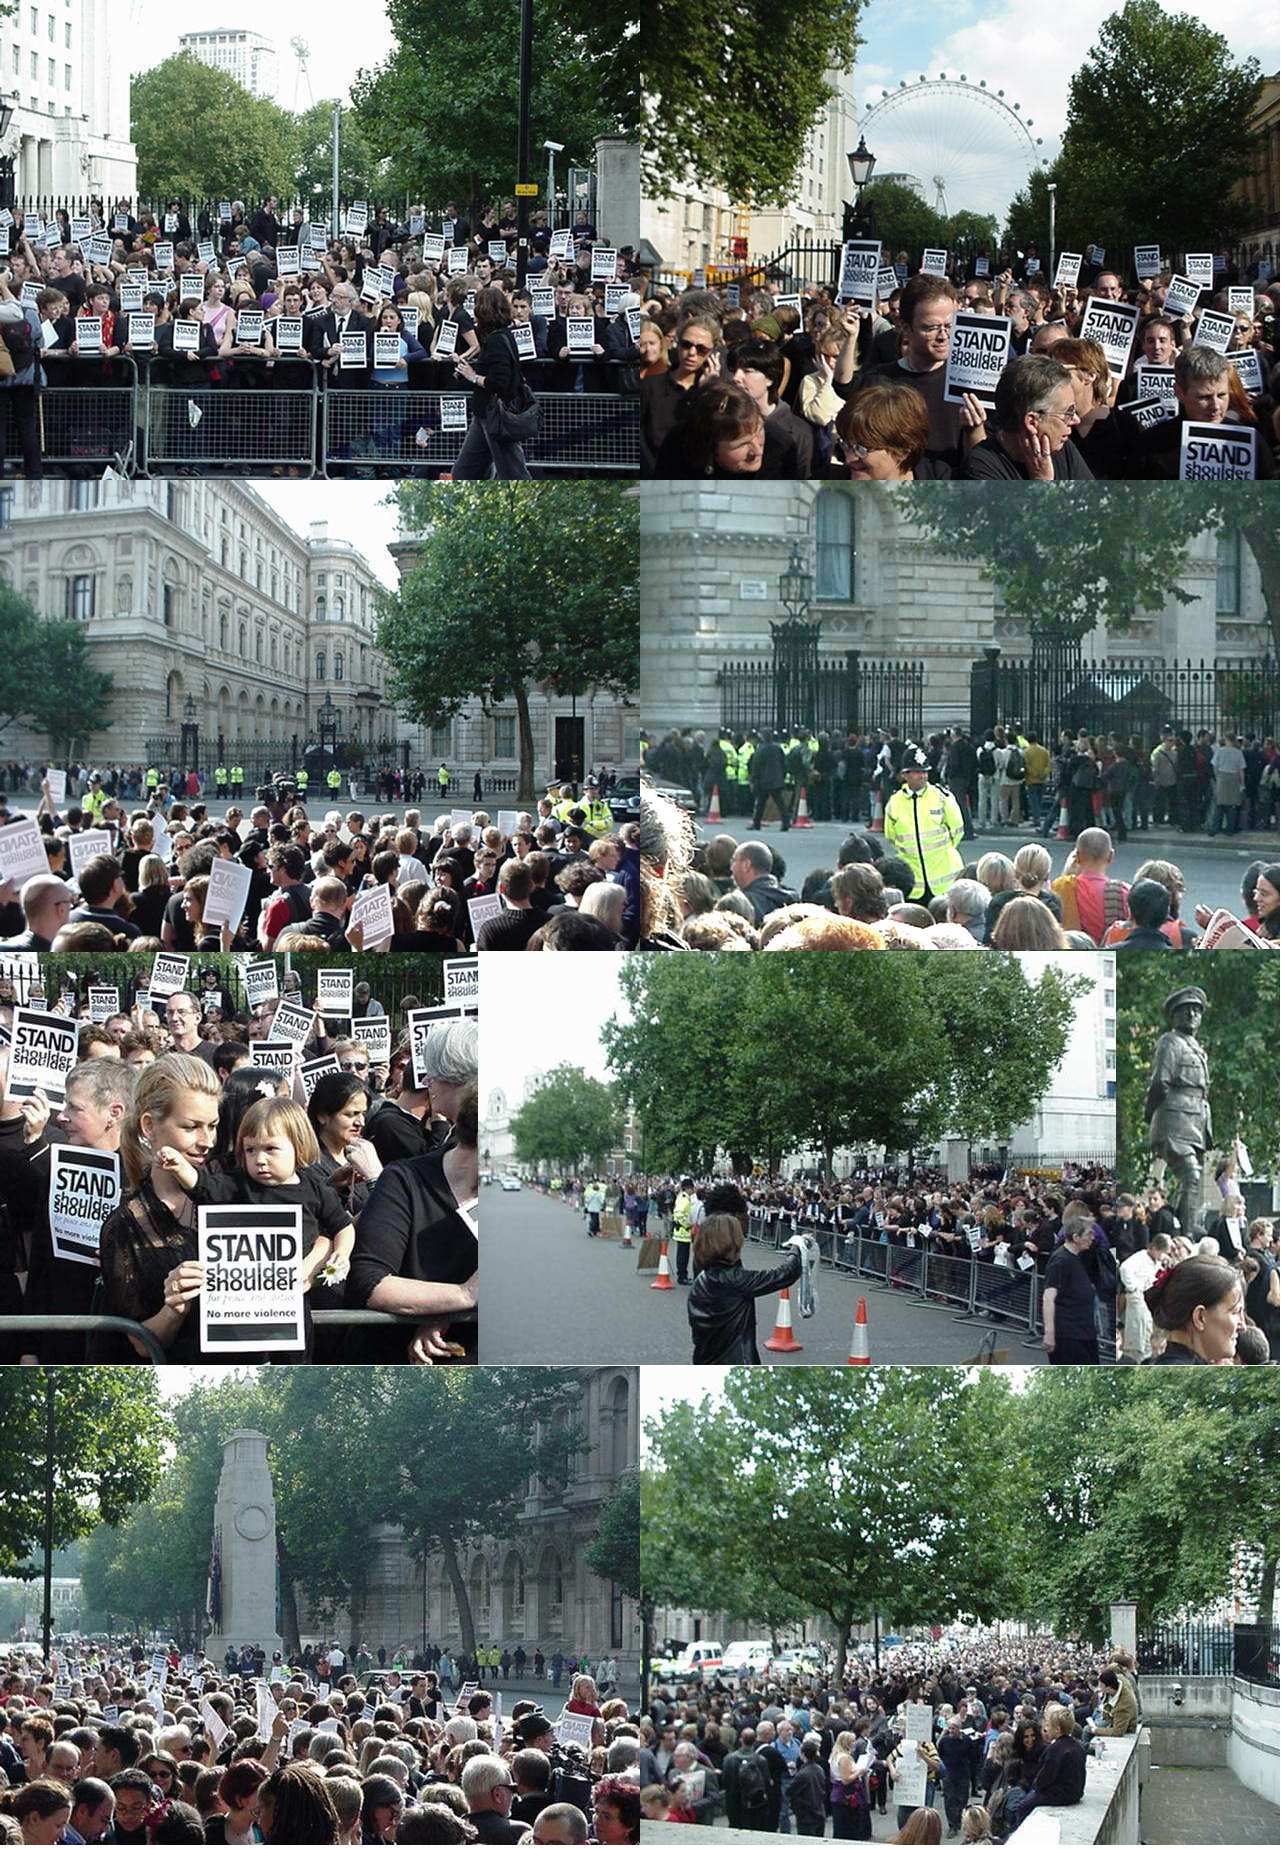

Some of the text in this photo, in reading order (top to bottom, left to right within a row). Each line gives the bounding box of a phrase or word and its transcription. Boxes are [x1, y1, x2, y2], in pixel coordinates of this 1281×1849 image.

[594, 255, 615, 263] STAND
[845, 253, 877, 269] STAND
[925, 255, 945, 265] STAND
[1136, 252, 1158, 262] STAND
[1188, 261, 1211, 269] STAND
[182, 280, 203, 288] STAND
[1170, 282, 1198, 298] STAND
[131, 320, 153, 328] STAND
[240, 316, 262, 325] STAND
[1086, 312, 1133, 334] STAND
[1201, 318, 1232, 336] STAND
[78, 323, 101, 332] STAND
[176, 327, 198, 336] STAND
[279, 323, 301, 332] STAND
[568, 324, 592, 332] STAND
[342, 338, 365, 347] STAND
[376, 338, 399, 347] STAND
[953, 329, 1006, 353] STAND
[442, 401, 465, 410] STAND
[1186, 441, 1252, 466] STAND
[156, 961, 186, 976] STAND
[246, 969, 275, 985] STAND
[320, 978, 351, 989] STAND
[447, 970, 478, 985] STAN
[91, 995, 117, 1005] STAND
[276, 1011, 310, 1031] STAND
[15, 1027, 74, 1053] STAND
[354, 1027, 388, 1041] STAND
[13, 1054, 72, 1073] shoulder
[253, 1053, 293, 1066] STAND
[56, 1167, 116, 1199] STAND
[53, 1201, 110, 1222] shoulde
[206, 1234, 297, 1262] STAND
[206, 1263, 297, 1280] shoulder
[206, 1277, 297, 1291] shoulder
[207, 1310, 220, 1318] No
[254, 1309, 296, 1318] violence
